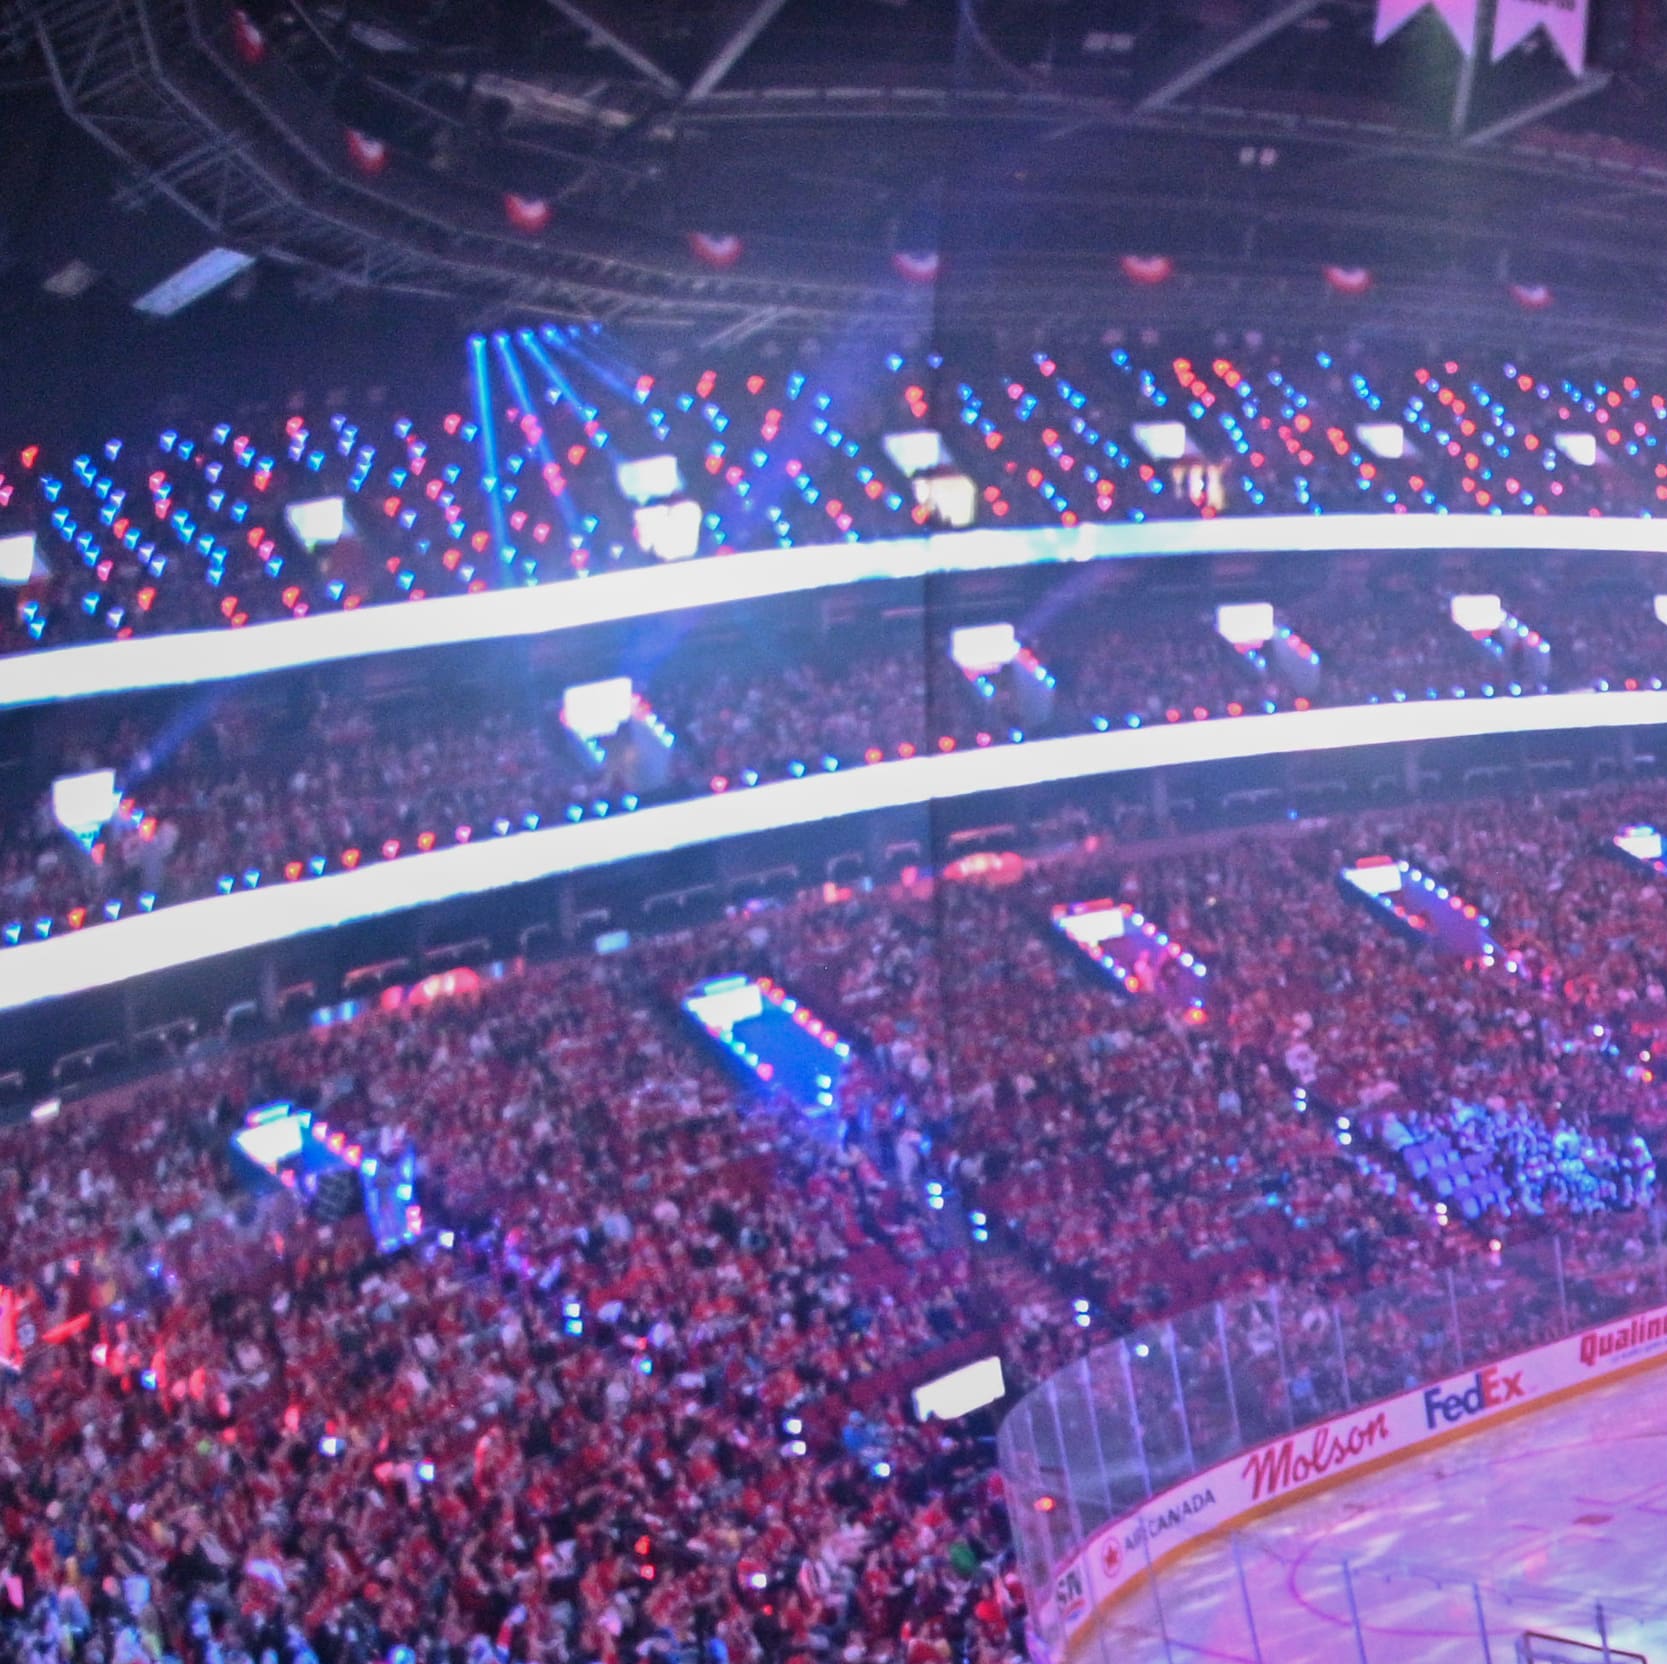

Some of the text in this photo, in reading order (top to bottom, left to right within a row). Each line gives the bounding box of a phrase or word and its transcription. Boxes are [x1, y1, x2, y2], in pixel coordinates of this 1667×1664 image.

[1423, 1367, 1525, 1430] FedEx
[1242, 1412, 1389, 1501] Molson
[1148, 1488, 1217, 1539] CANADA
